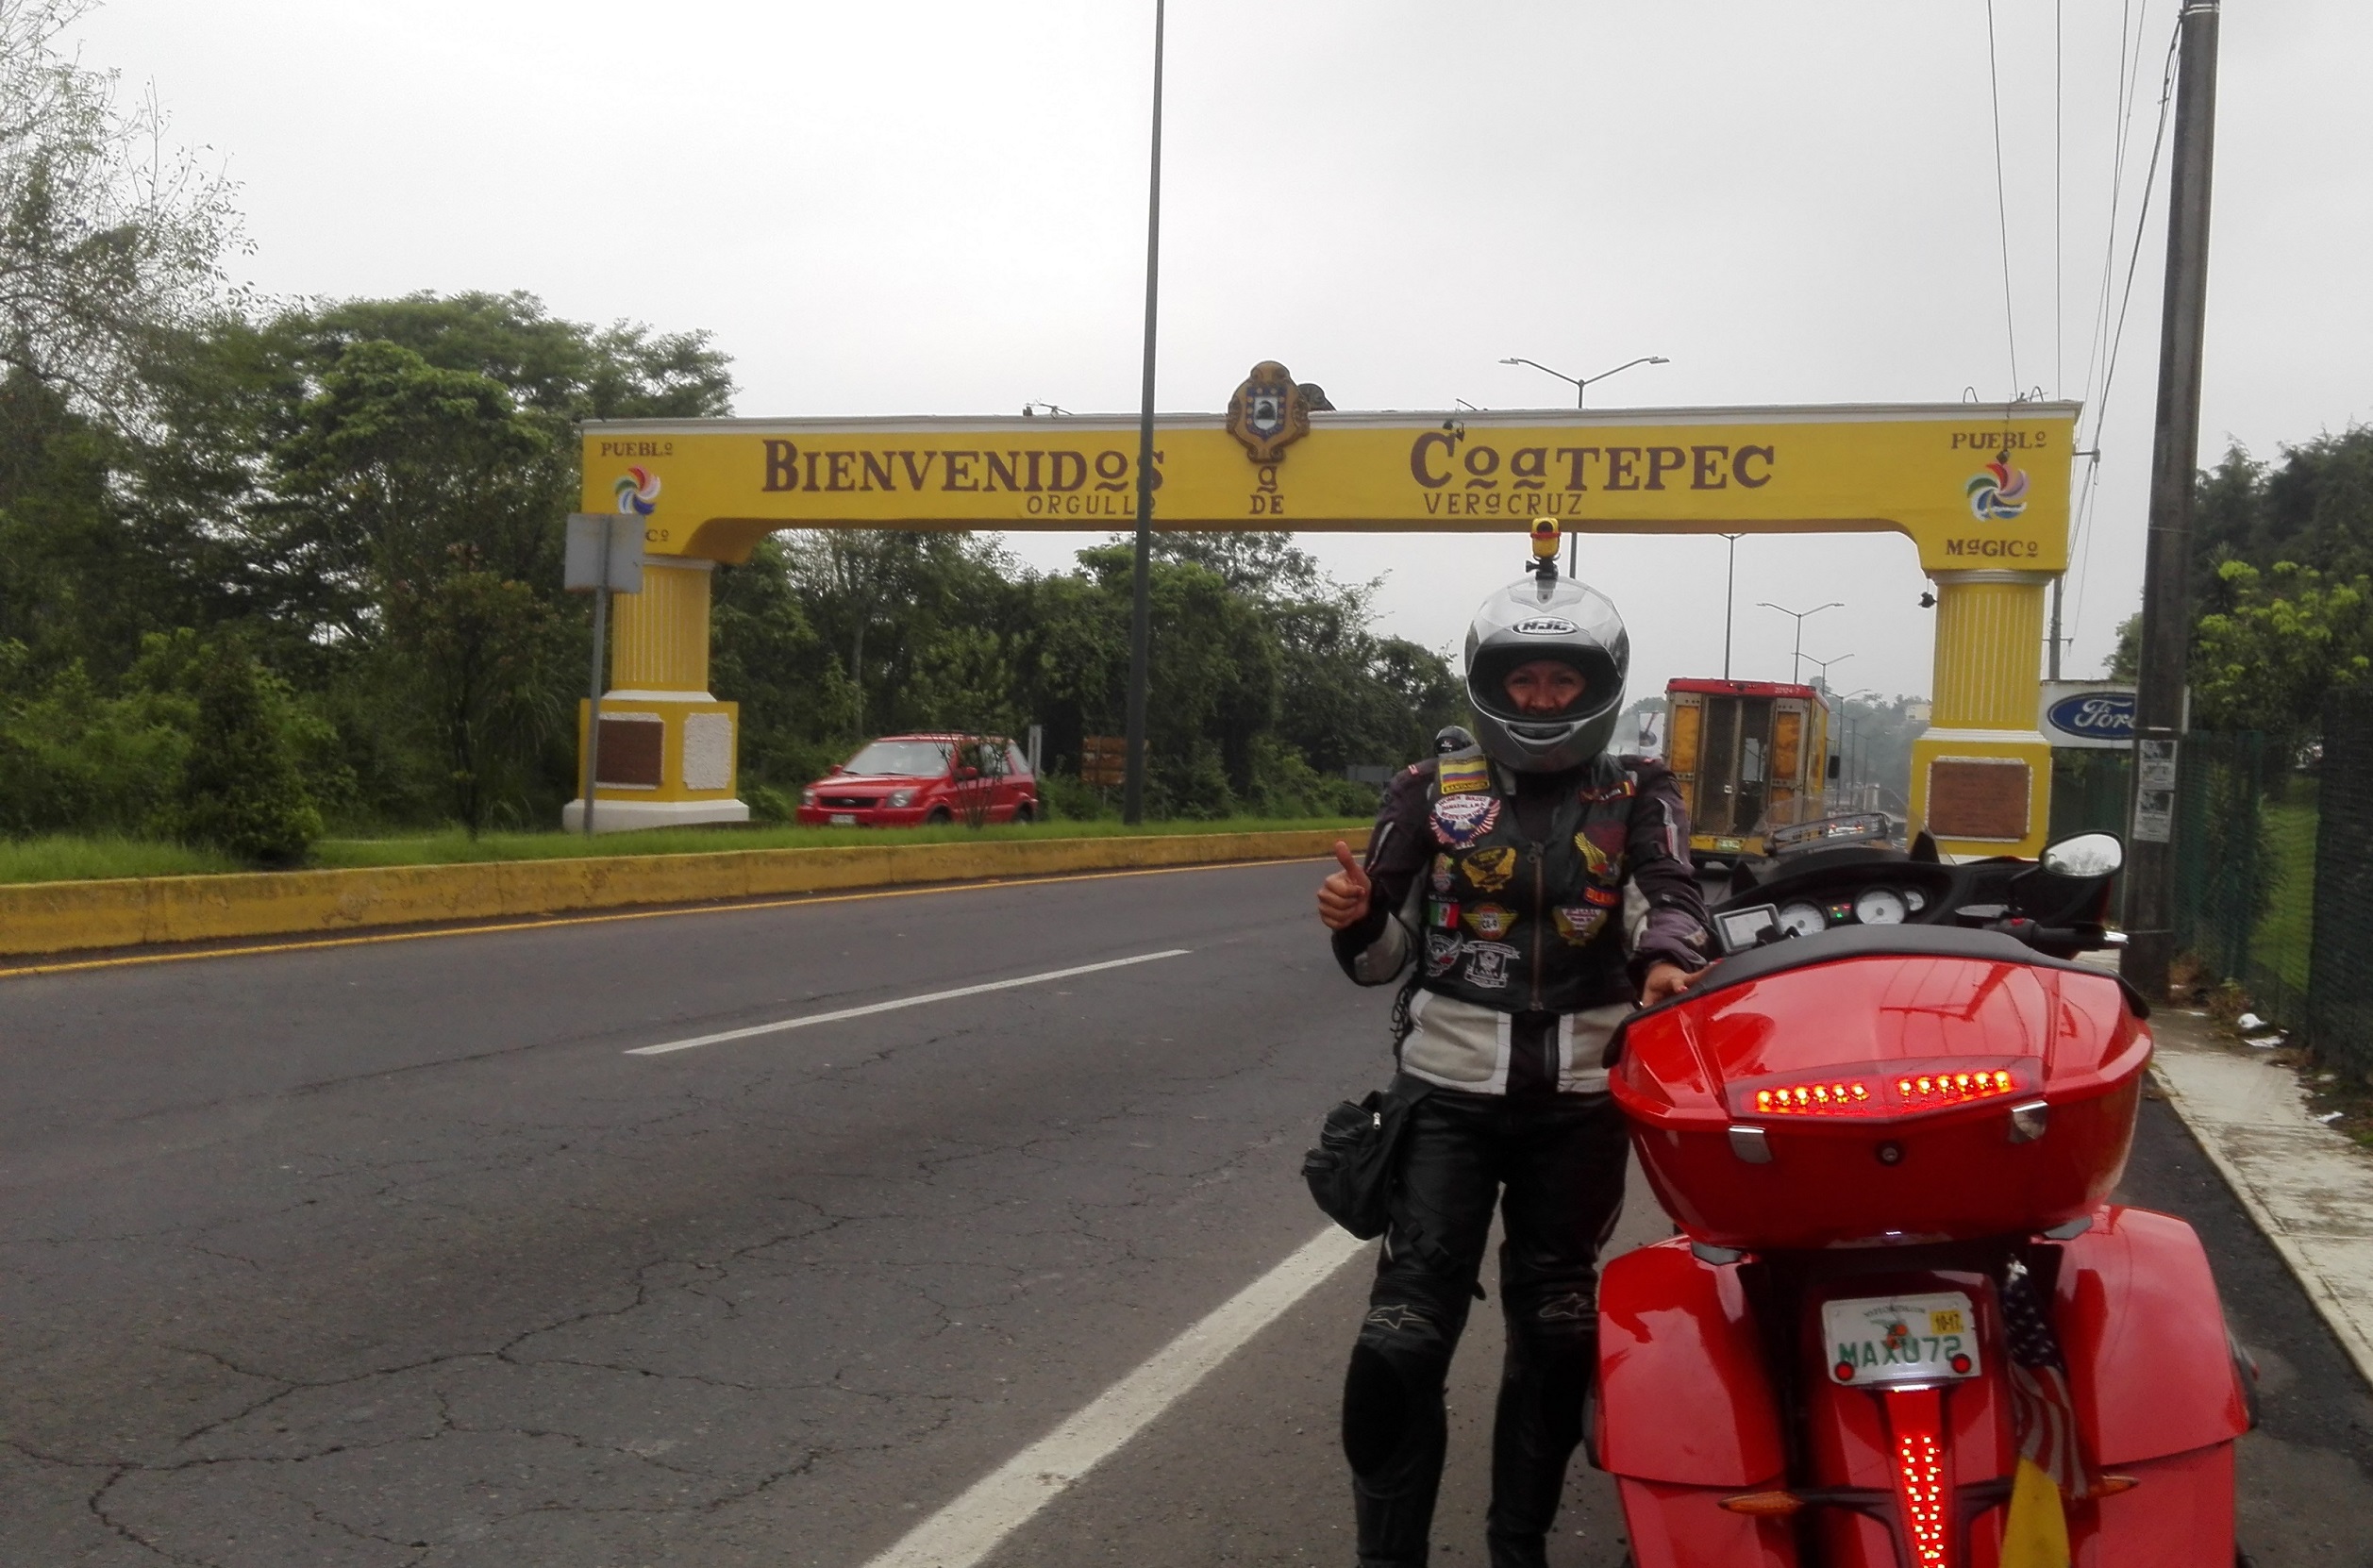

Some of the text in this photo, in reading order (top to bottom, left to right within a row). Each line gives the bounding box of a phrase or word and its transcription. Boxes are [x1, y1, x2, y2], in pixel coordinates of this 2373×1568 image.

[600, 442, 674, 457] PUEBLO
[1951, 431, 2047, 450] PUEBLO
[1249, 493, 1284, 515] DE
[1522, 621, 1569, 631] HJC
[1838, 1336, 1963, 1369] MAXU72
